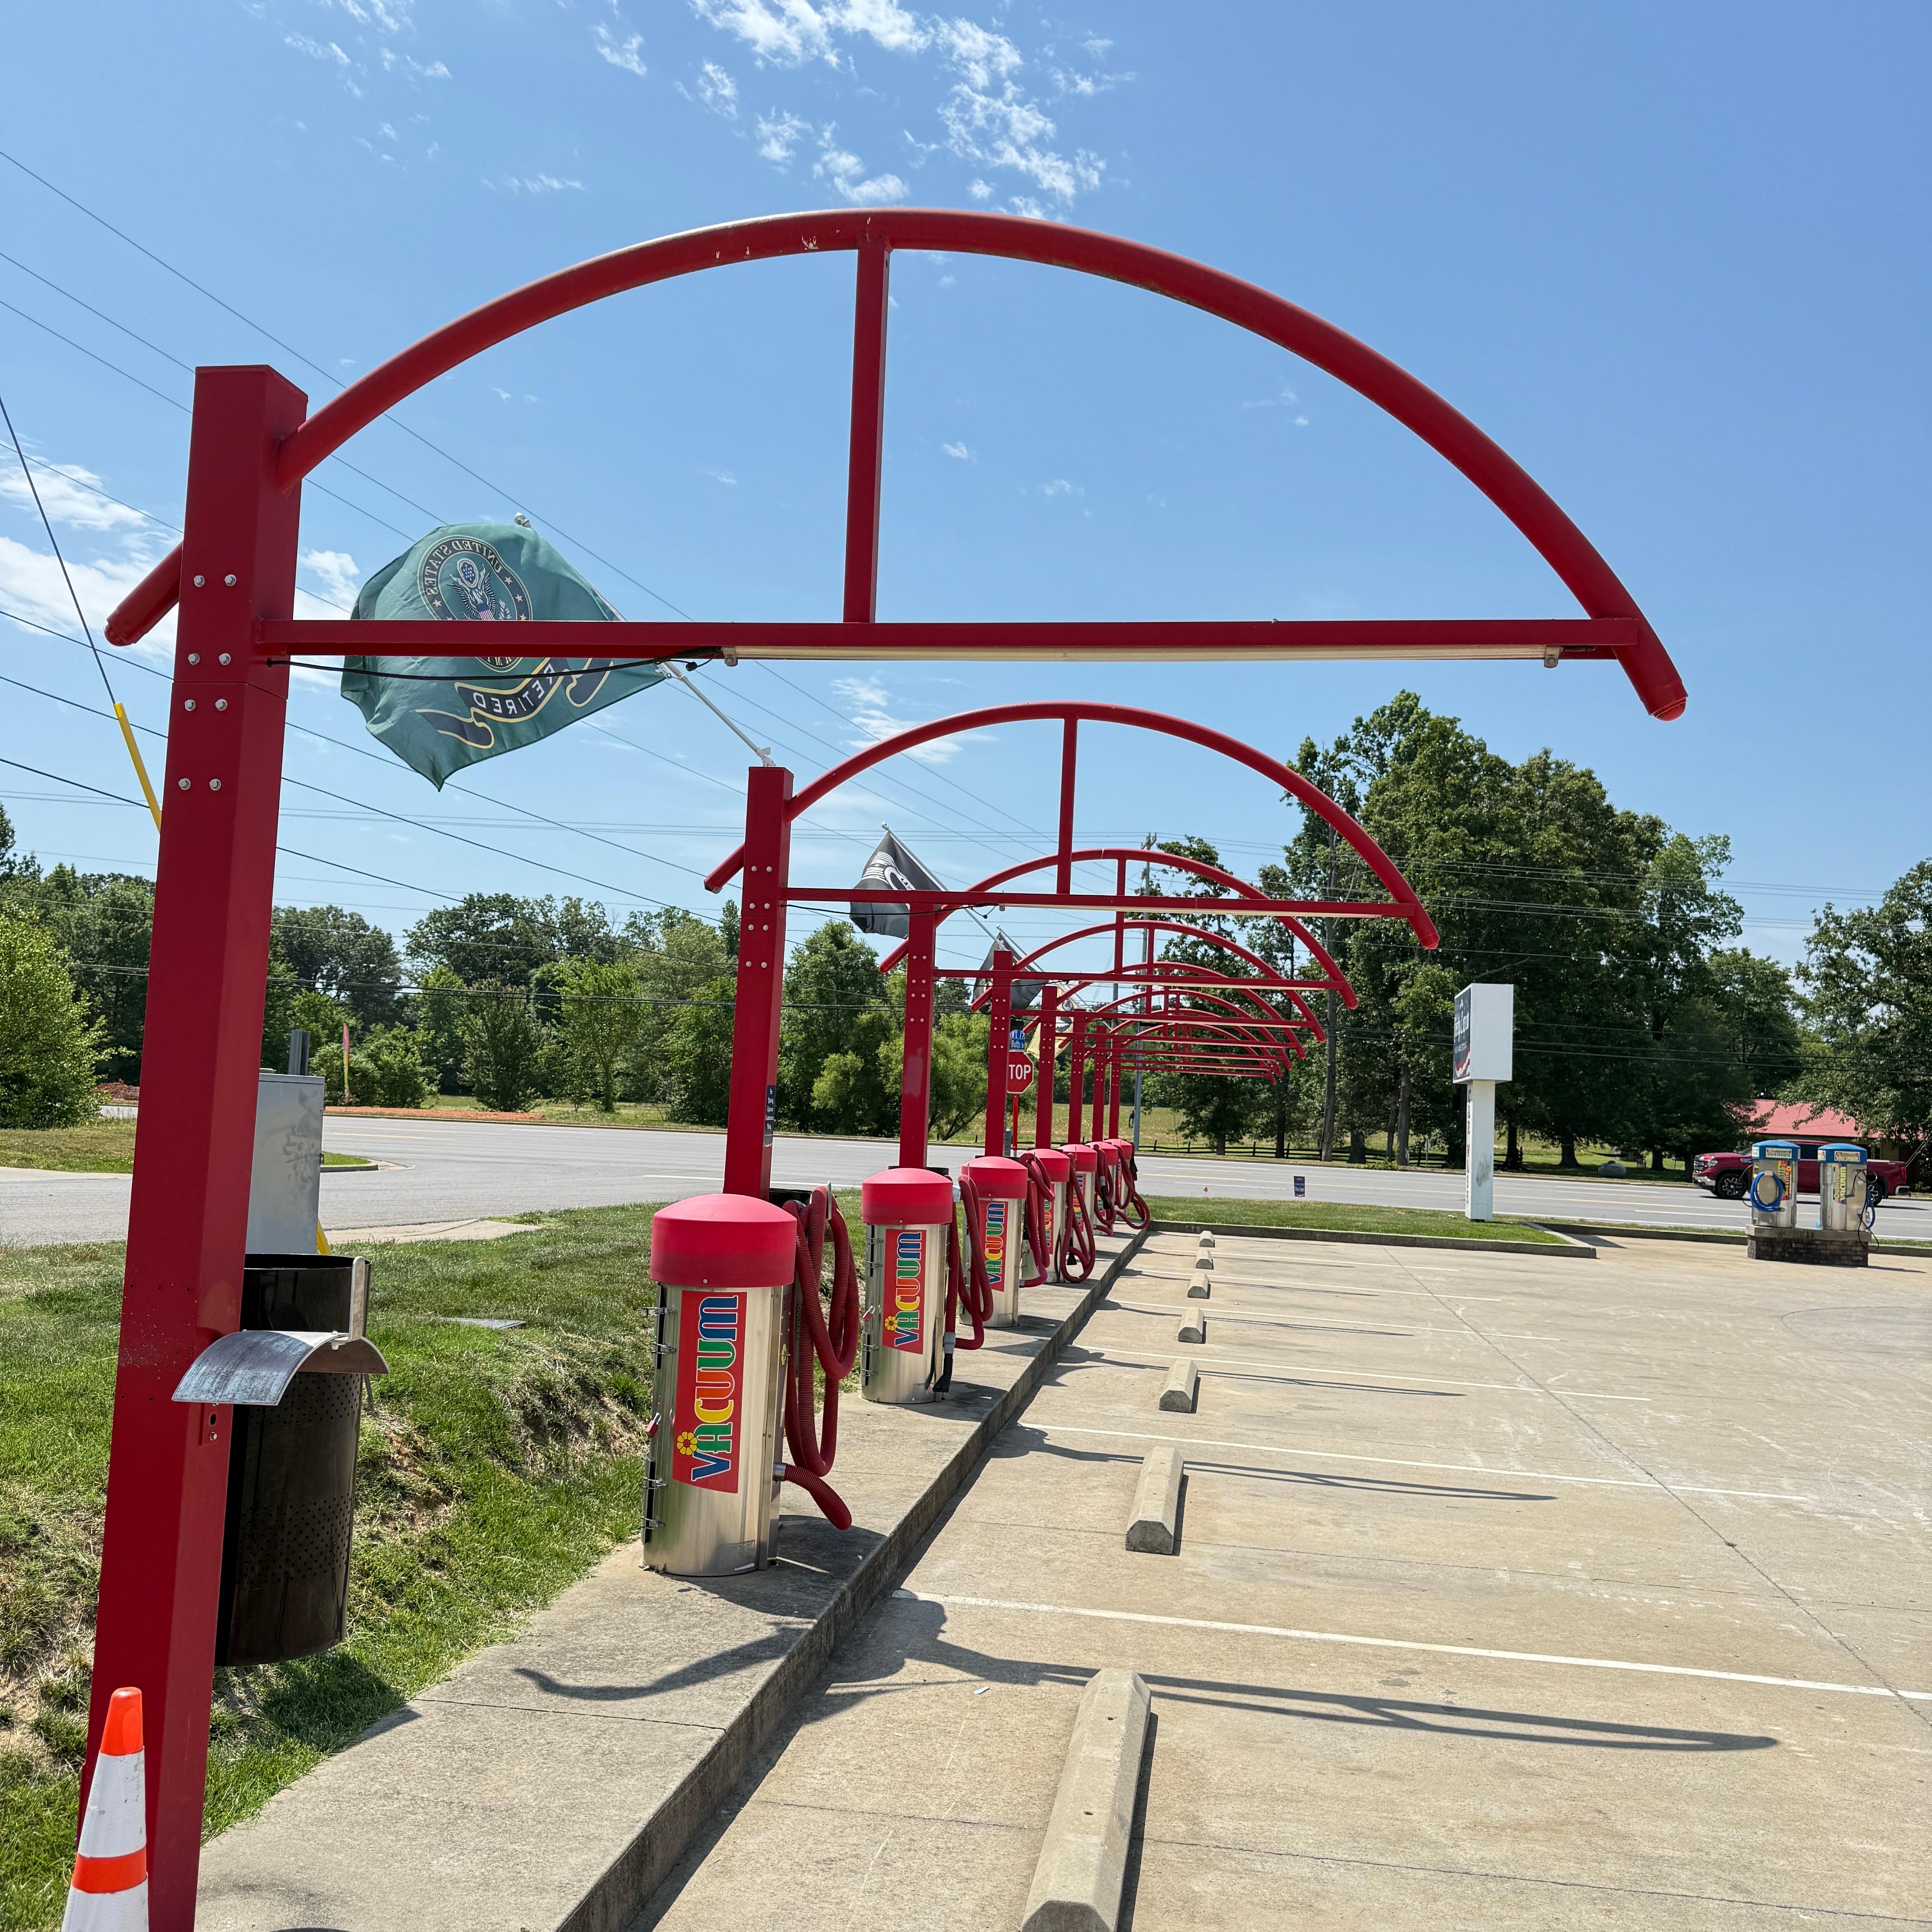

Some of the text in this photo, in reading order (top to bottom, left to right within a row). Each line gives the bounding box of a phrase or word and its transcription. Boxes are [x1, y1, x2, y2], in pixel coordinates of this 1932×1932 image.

[1009, 1064, 1031, 1080] TOP
[894, 1231, 922, 1347] VACUUM
[690, 1295, 739, 1481] VACUUM
